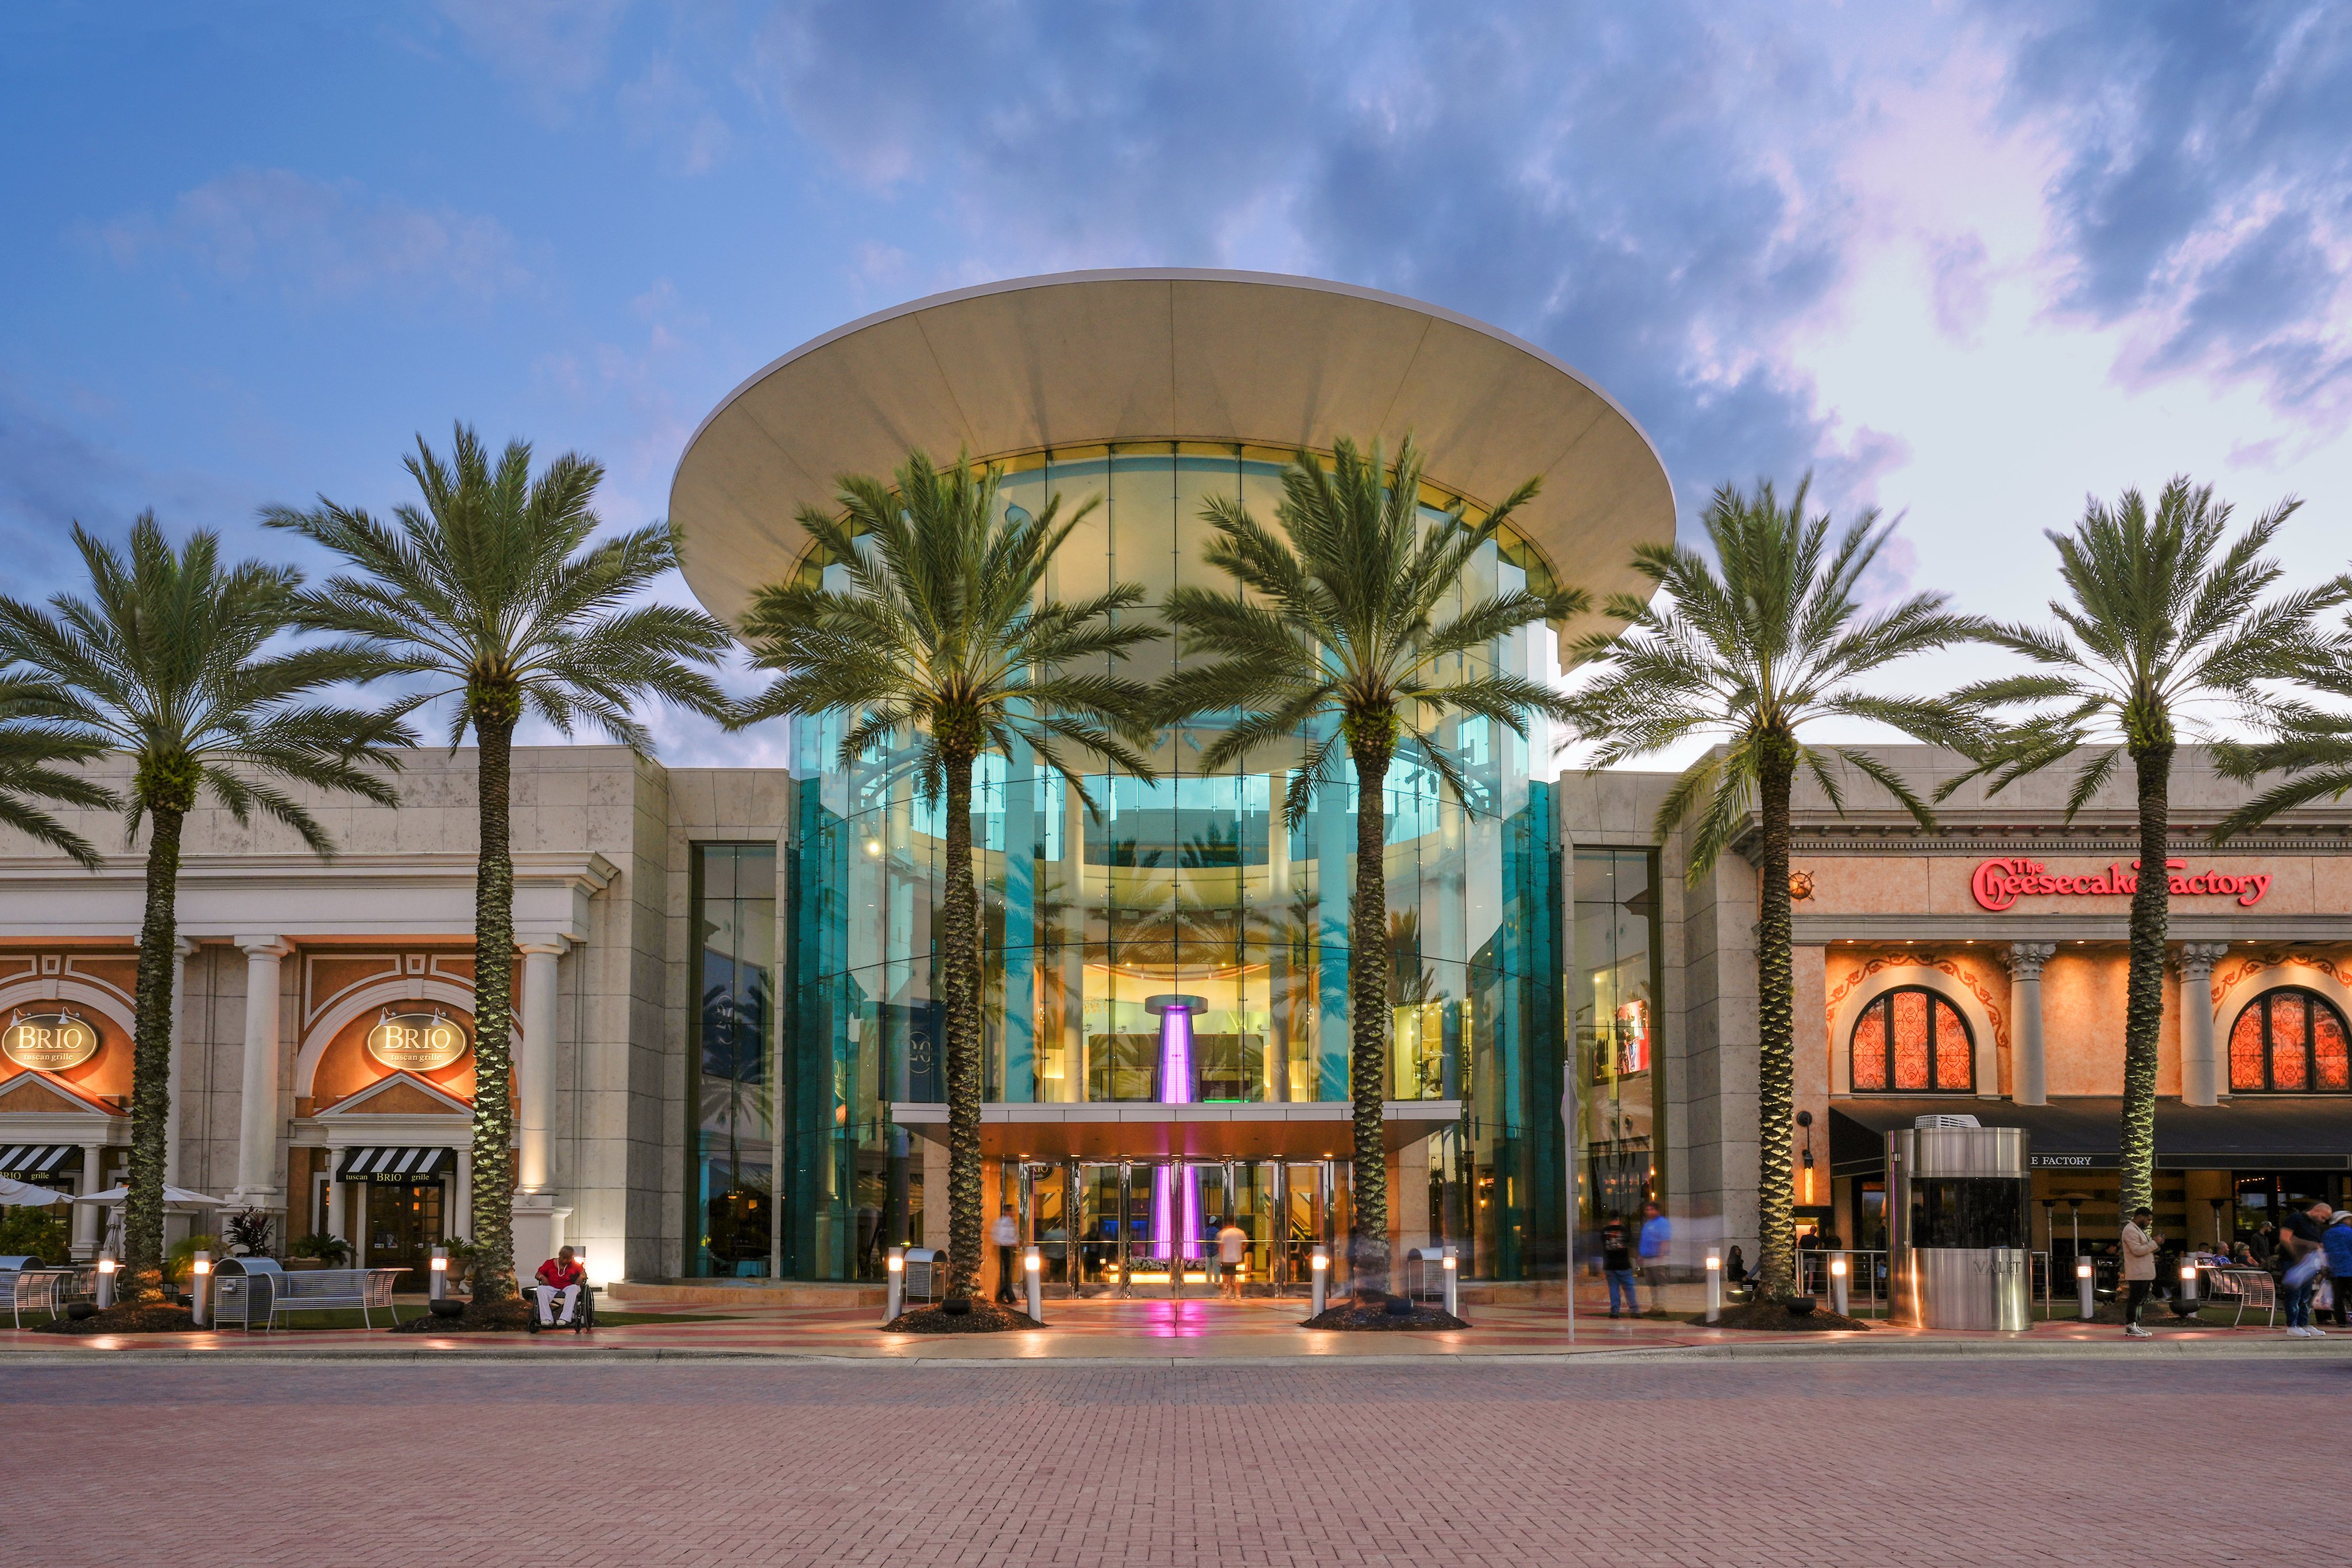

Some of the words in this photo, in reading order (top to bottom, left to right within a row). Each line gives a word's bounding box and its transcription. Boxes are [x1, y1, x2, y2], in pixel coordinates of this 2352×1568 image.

[2013, 859, 2045, 876] The
[16, 1025, 83, 1050] BRIO
[382, 1025, 451, 1050] BRIO
[51, 1053, 74, 1062] grille
[419, 1053, 442, 1063] grille
[2042, 1156, 2092, 1166] FACTORY
[0, 1172, 21, 1180] RIO
[31, 1172, 49, 1180] grille
[376, 1172, 402, 1182] BRIO
[411, 1174, 430, 1182] grille
[1973, 1260, 2021, 1273] VALET
